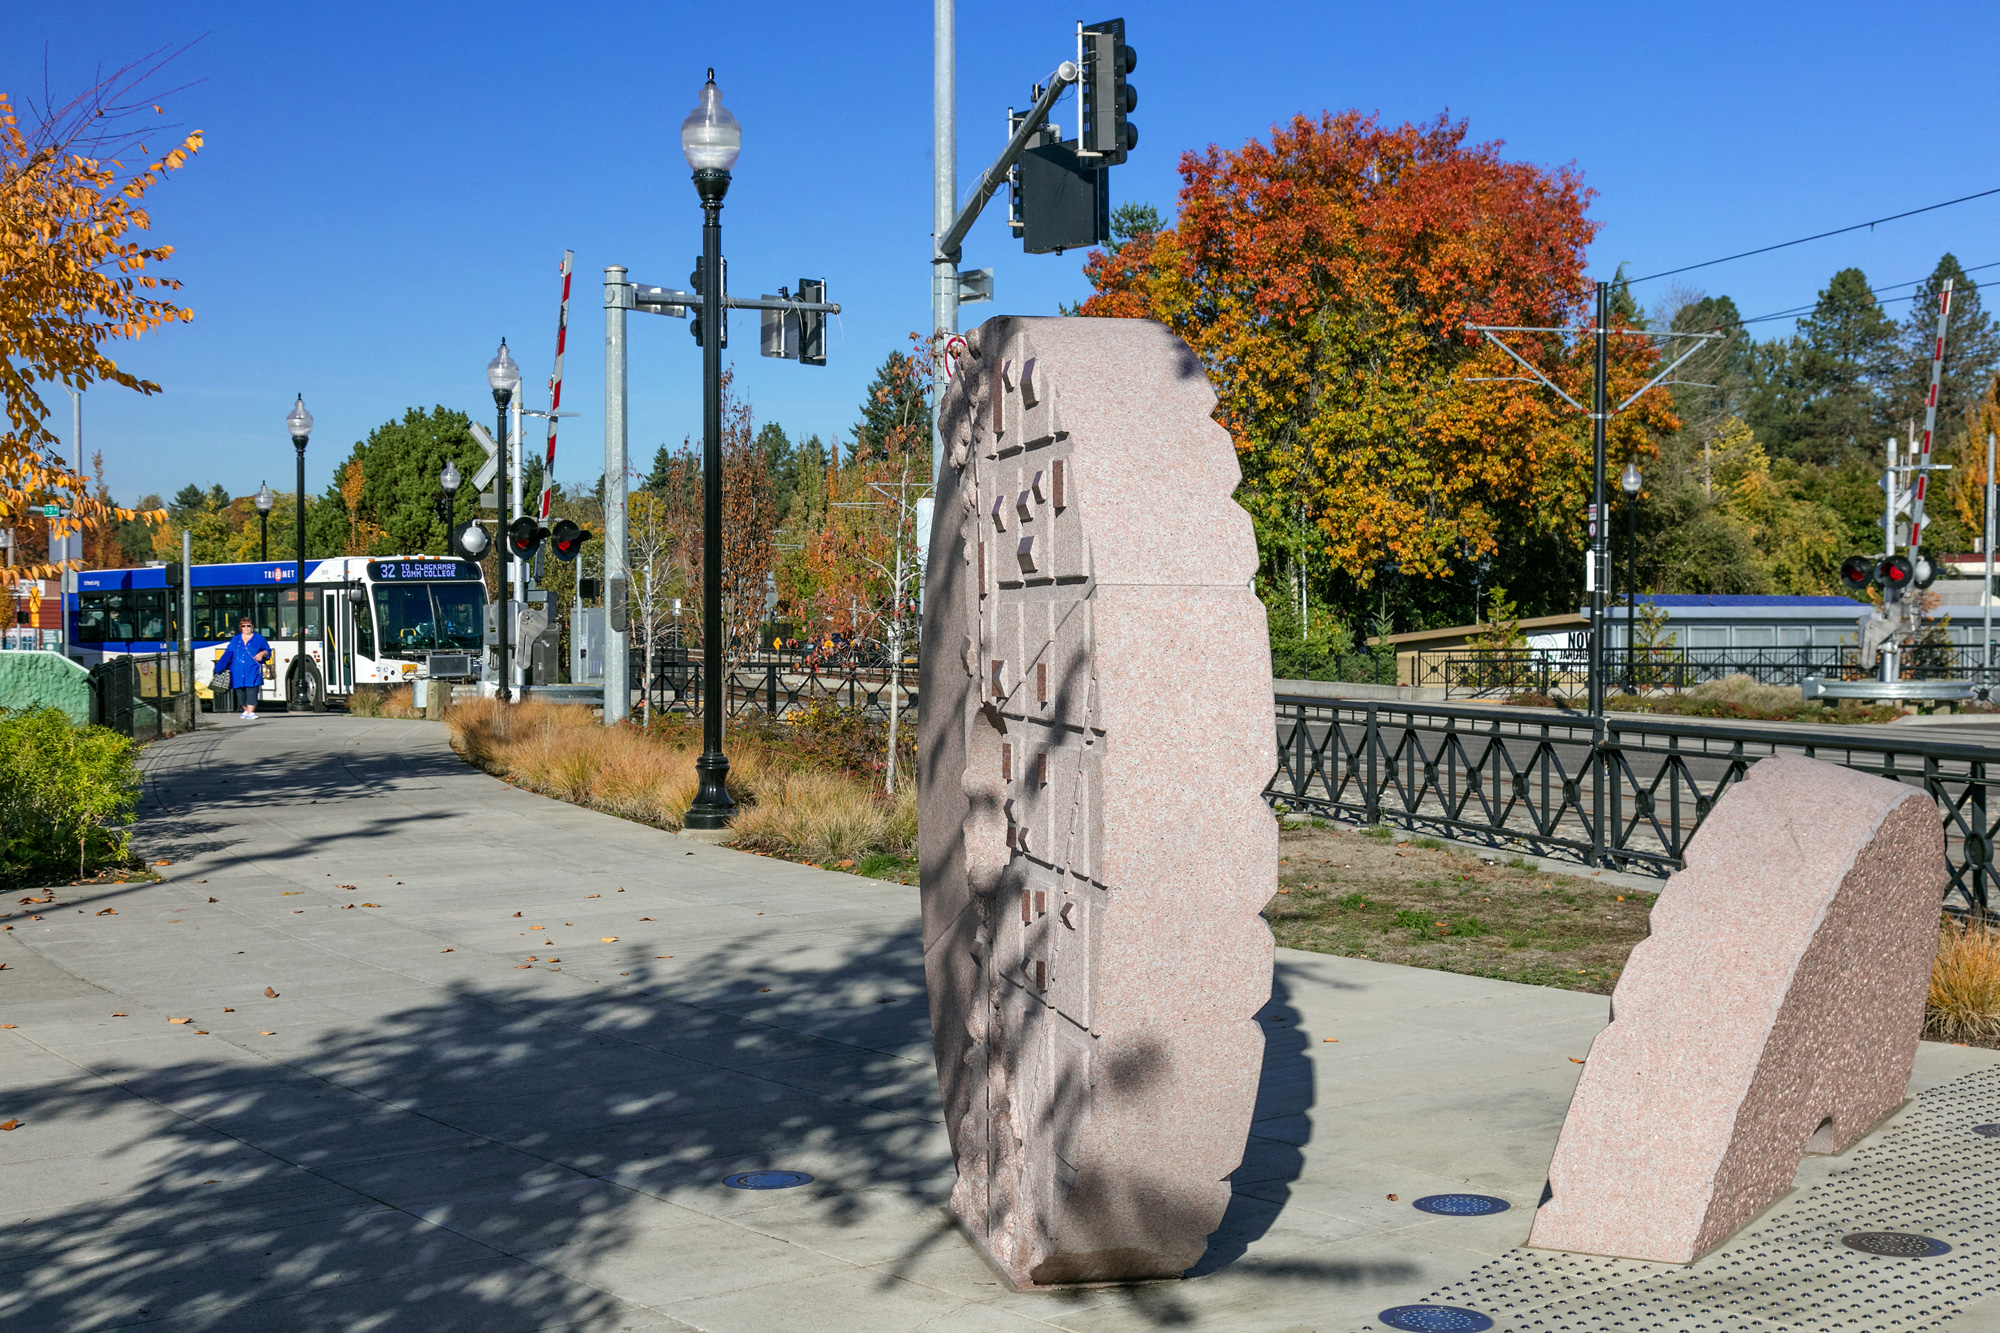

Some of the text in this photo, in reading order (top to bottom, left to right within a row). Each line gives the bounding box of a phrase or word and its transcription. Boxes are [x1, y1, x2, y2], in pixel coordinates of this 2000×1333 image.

[380, 563, 396, 578] 32
[401, 563, 457, 571] TO CLACKAMAS
[401, 570, 456, 578] COMM COLLEGE
